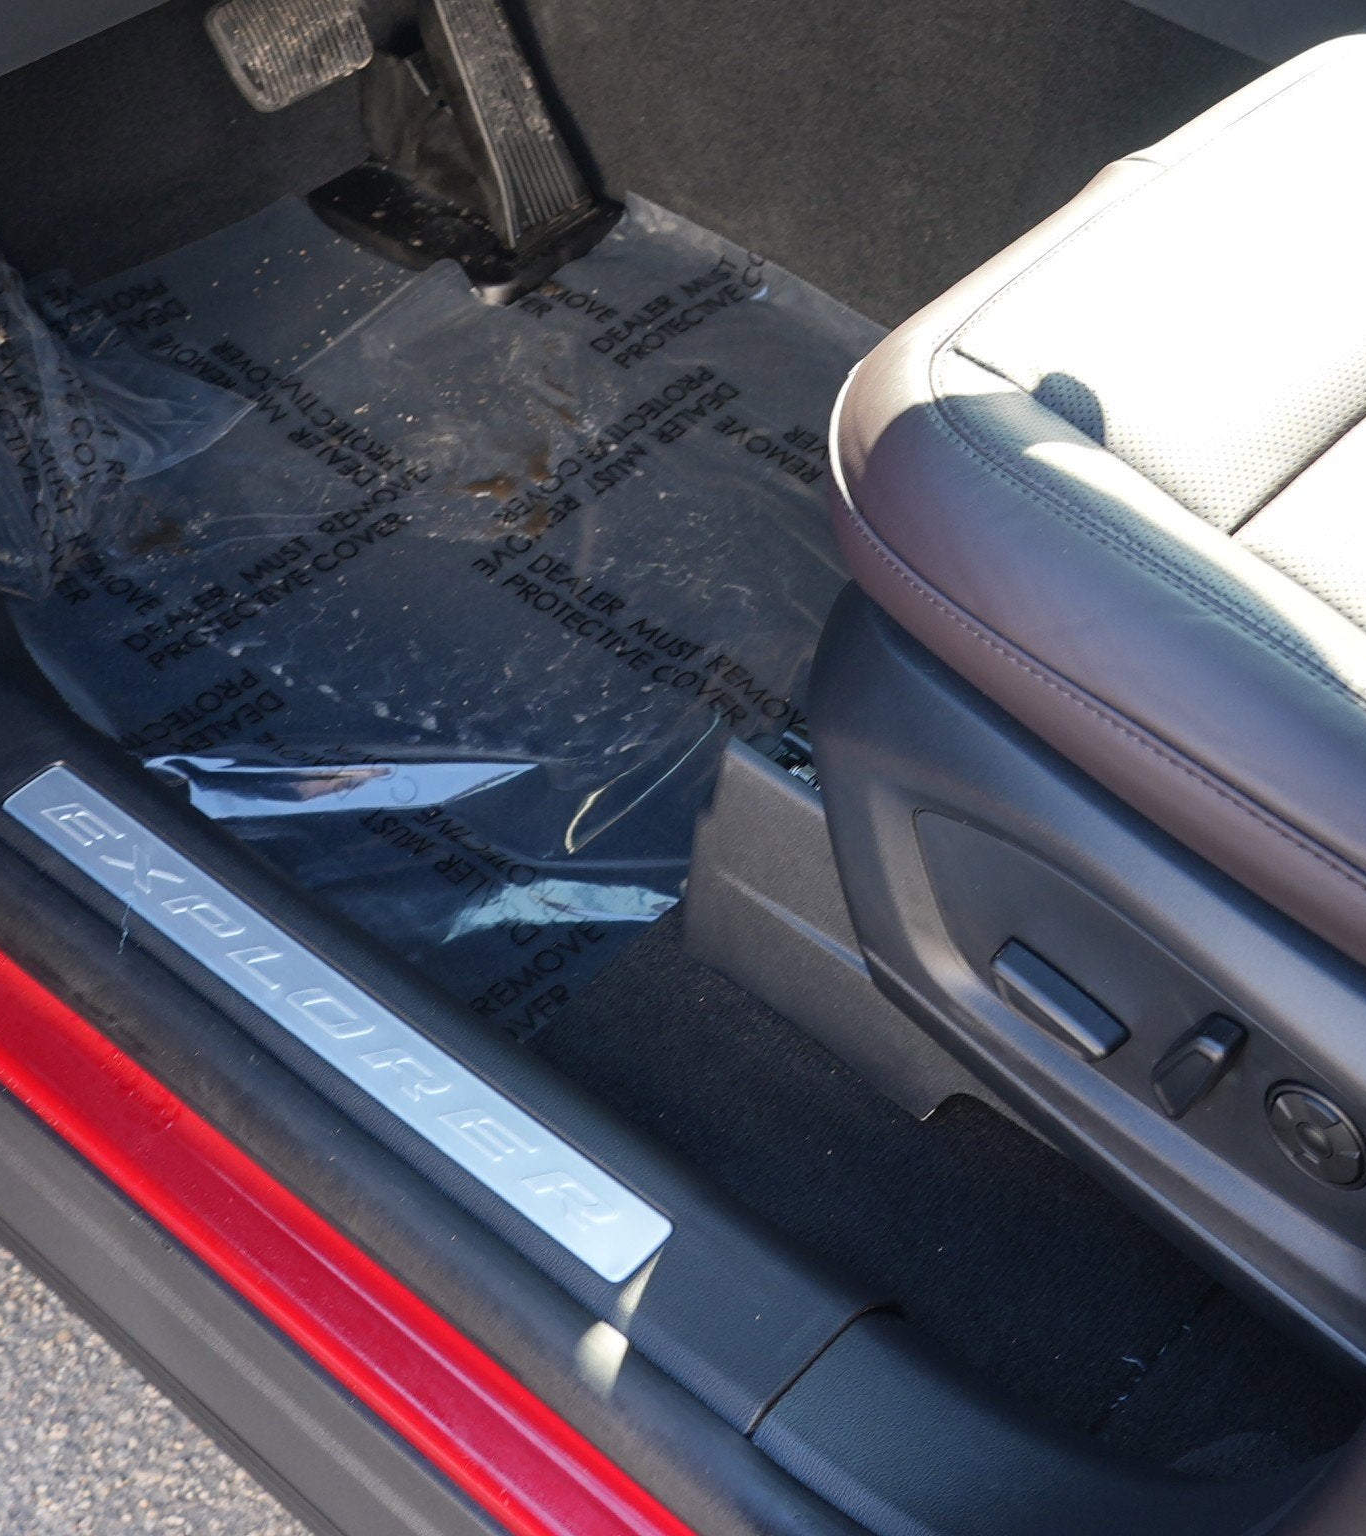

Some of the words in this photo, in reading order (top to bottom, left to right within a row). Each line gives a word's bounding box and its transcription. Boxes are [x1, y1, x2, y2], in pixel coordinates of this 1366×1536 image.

[589, 295, 675, 354] DEALER
[613, 284, 744, 369] PROTECTIVE
[275, 375, 405, 469] PROTECTIV
[580, 366, 715, 465] PROTECTIVE
[649, 381, 739, 445] DEALER
[713, 416, 823, 484] REMOVE
[782, 424, 828, 462] VER
[288, 428, 378, 488] DEALER
[492, 457, 583, 526] COVER
[585, 444, 651, 496] MUST
[312, 513, 408, 571] COVER
[471, 492, 583, 579] REOVE
[121, 586, 227, 653] DEALER
[238, 534, 312, 586] MUST
[502, 573, 655, 670] PROTECTIVE
[652, 664, 746, 726] COVER
[527, 553, 629, 617] DEALER
[627, 617, 704, 662] MUST
[706, 654, 809, 728] REMOV
[469, 923, 606, 1015] REMOVE
[38, 800, 622, 1234] EXPLORER
